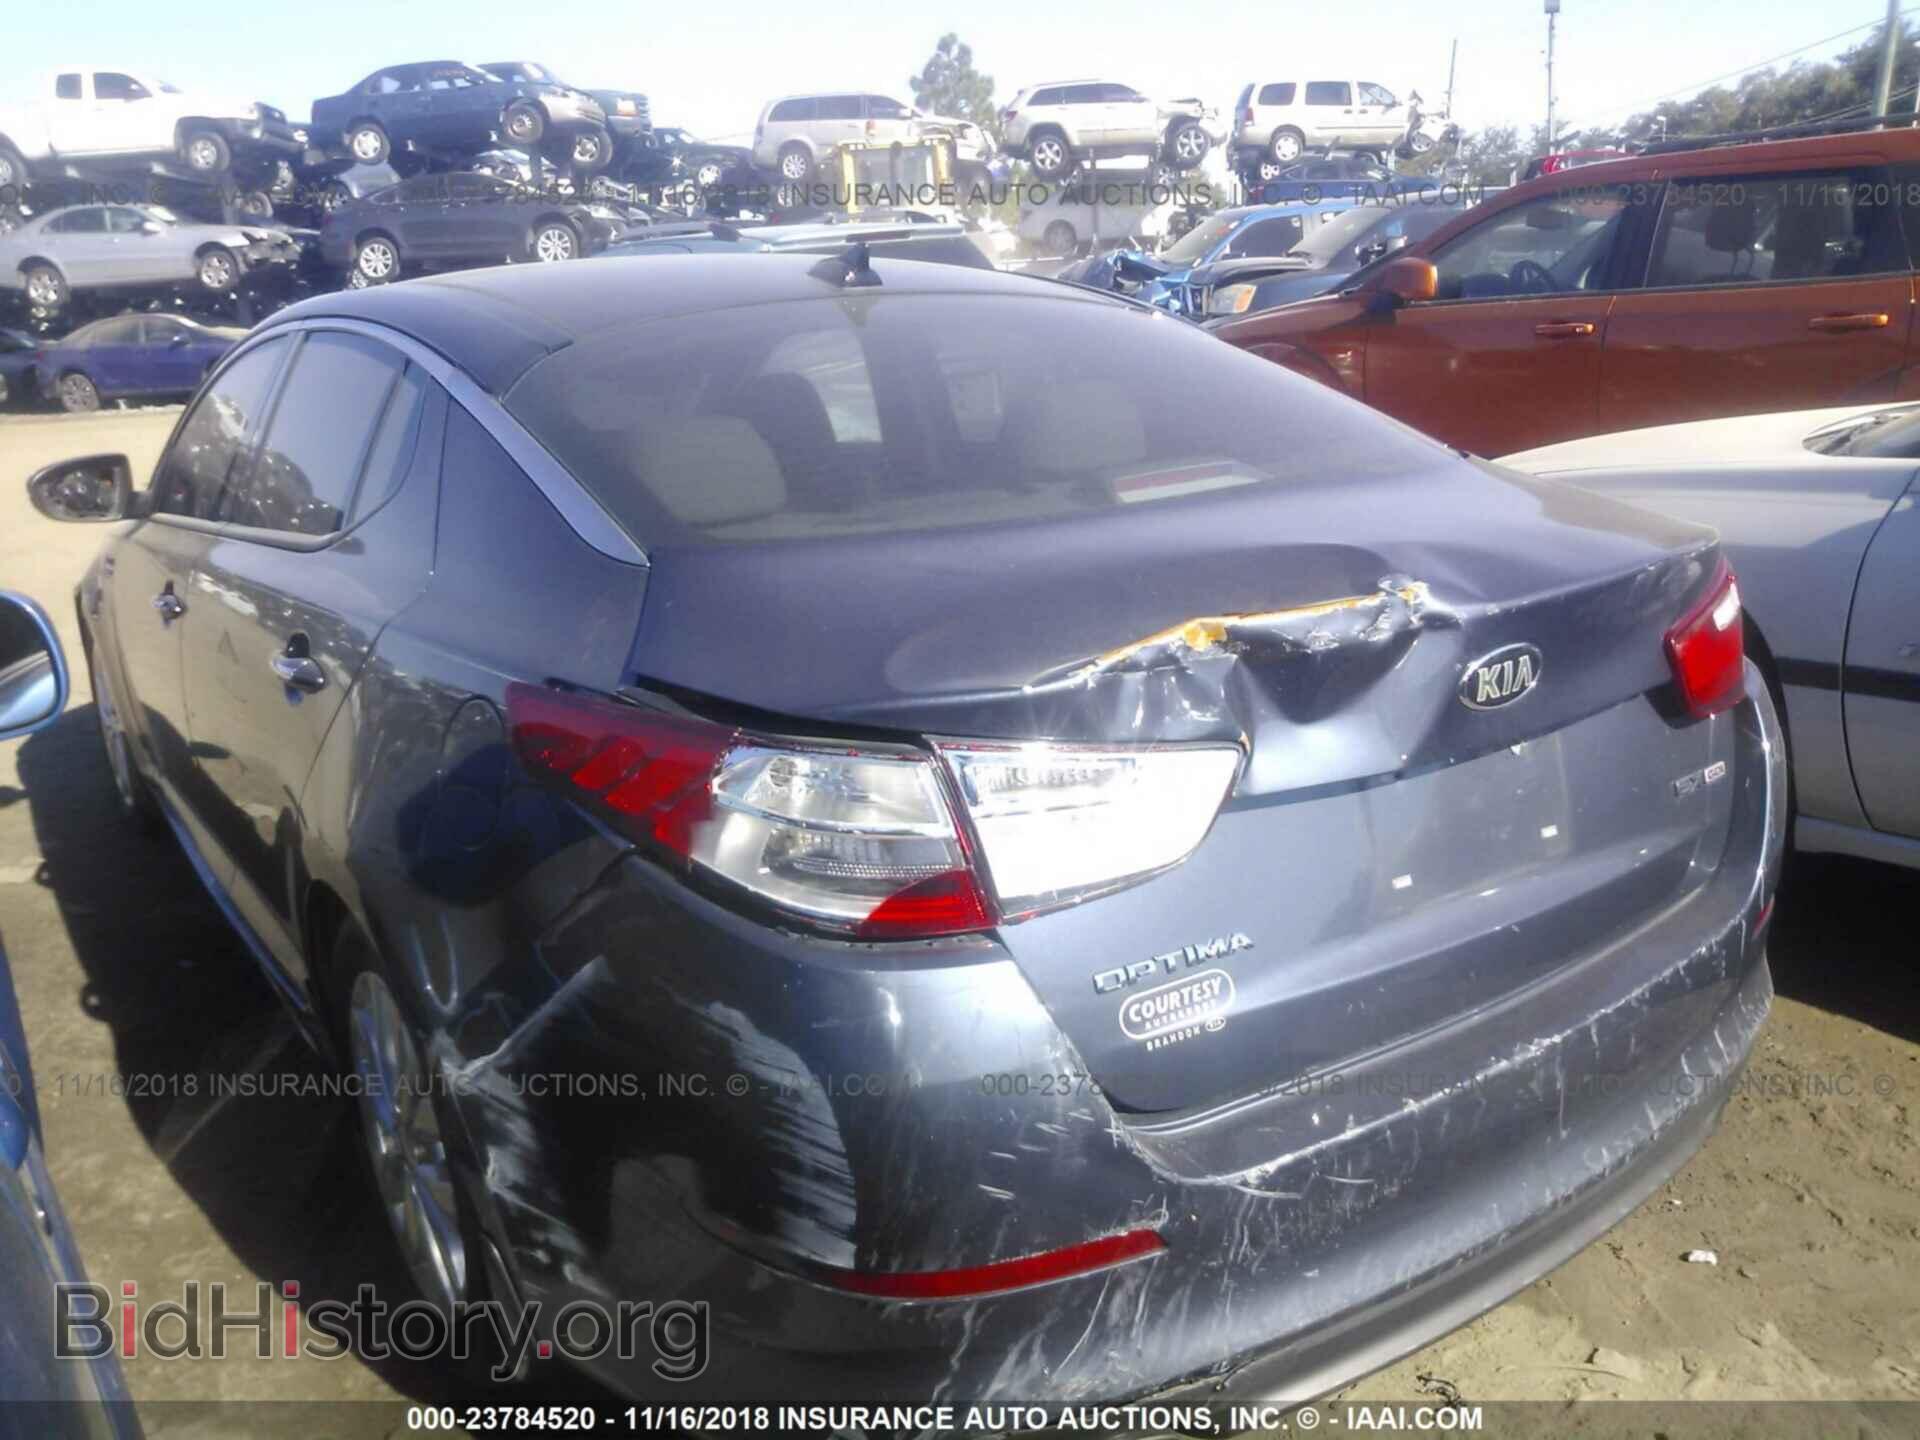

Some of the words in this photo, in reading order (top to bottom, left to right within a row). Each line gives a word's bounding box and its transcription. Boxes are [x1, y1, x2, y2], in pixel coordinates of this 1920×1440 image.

[1477, 655, 1534, 702] KIA
[1093, 932, 1254, 994] OPTIMA
[1129, 976, 1222, 1022] COURTESY
